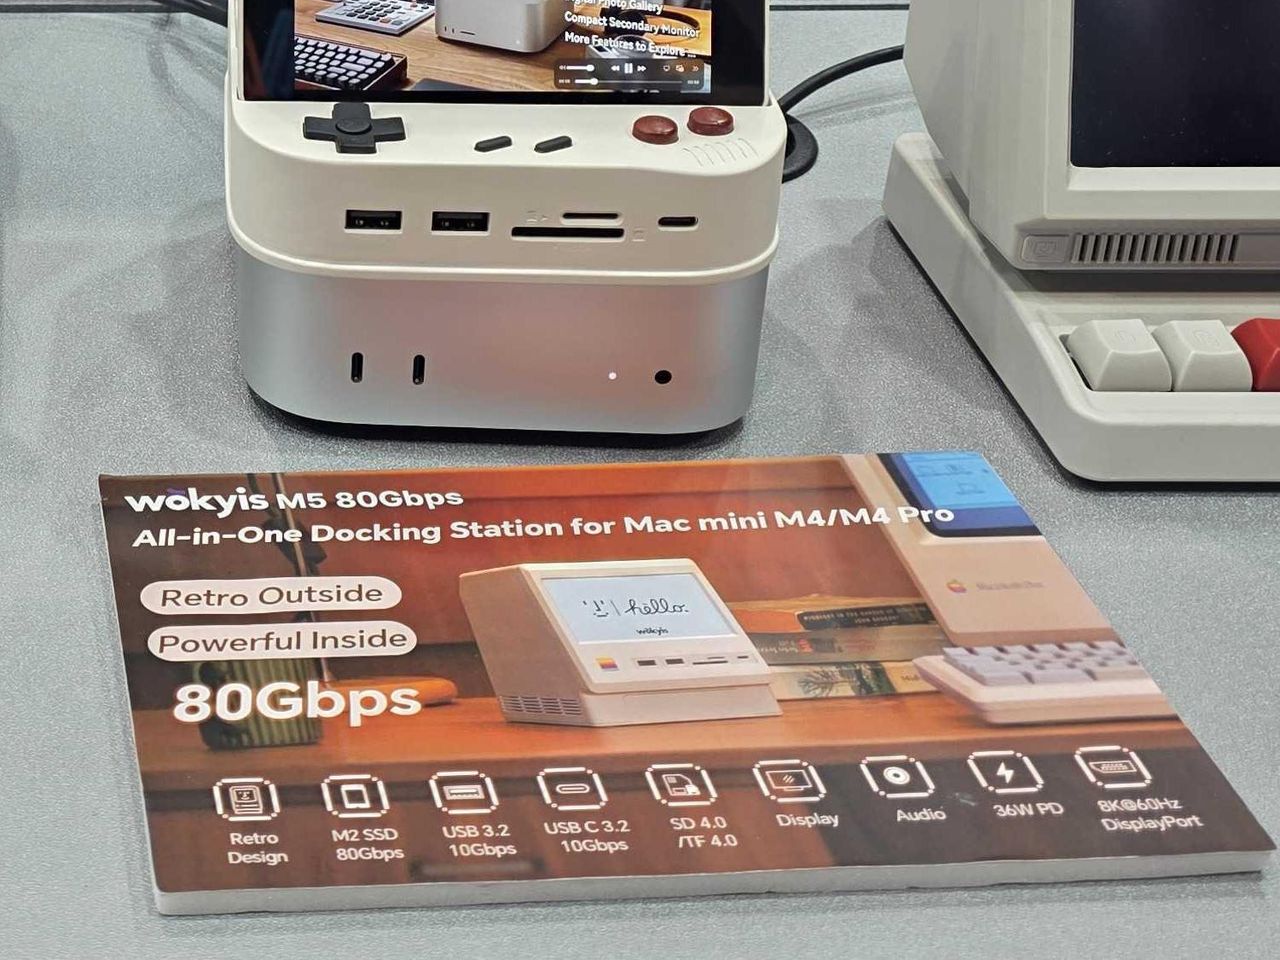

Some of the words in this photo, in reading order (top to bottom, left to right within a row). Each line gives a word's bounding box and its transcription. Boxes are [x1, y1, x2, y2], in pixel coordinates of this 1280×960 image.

[629, 0, 663, 14] Gallery
[564, 11, 607, 26] Compact
[609, 17, 660, 34] Secondary
[661, 25, 700, 37] Monitor
[564, 32, 589, 44] More
[592, 35, 634, 50] Features
[636, 41, 646, 52] to
[649, 42, 686, 57] Explore
[276, 492, 327, 510] M5
[335, 490, 464, 510] 80Gbps
[132, 526, 303, 547] All-in-One
[311, 523, 442, 544] Docking
[450, 518, 564, 539] Station
[570, 518, 616, 536] for
[624, 516, 692, 534] Mac
[698, 511, 768, 532] mini
[774, 506, 891, 528] M4/M4
[896, 506, 955, 524] Pro
[161, 589, 248, 608] Retro
[258, 584, 383, 606] Outside
[158, 631, 302, 654] Powerful
[312, 628, 408, 650] Inside
[172, 680, 422, 728] 80Gbps
[993, 804, 1036, 818] 36W
[1039, 802, 1064, 816] PD
[1097, 798, 1183, 813] 8K@60Hz
[776, 814, 839, 828] Display
[896, 808, 946, 822] Audio
[1101, 814, 1204, 832] DisplayPort
[442, 824, 478, 839] USB
[482, 824, 511, 838] 3.2
[544, 821, 580, 835] USB
[584, 820, 600, 834] C
[602, 820, 631, 833] 3.2
[670, 818, 696, 831] SD
[699, 816, 727, 830] 4.0
[230, 832, 279, 846] Retro
[332, 828, 360, 842] M2
[362, 828, 399, 841] SSD
[678, 836, 705, 849] /TF
[710, 834, 738, 848] 4.0
[336, 846, 405, 862] 80Gbps
[448, 844, 518, 858] 10Gbps
[561, 838, 630, 854] 10Gbps
[227, 850, 288, 866] Design
